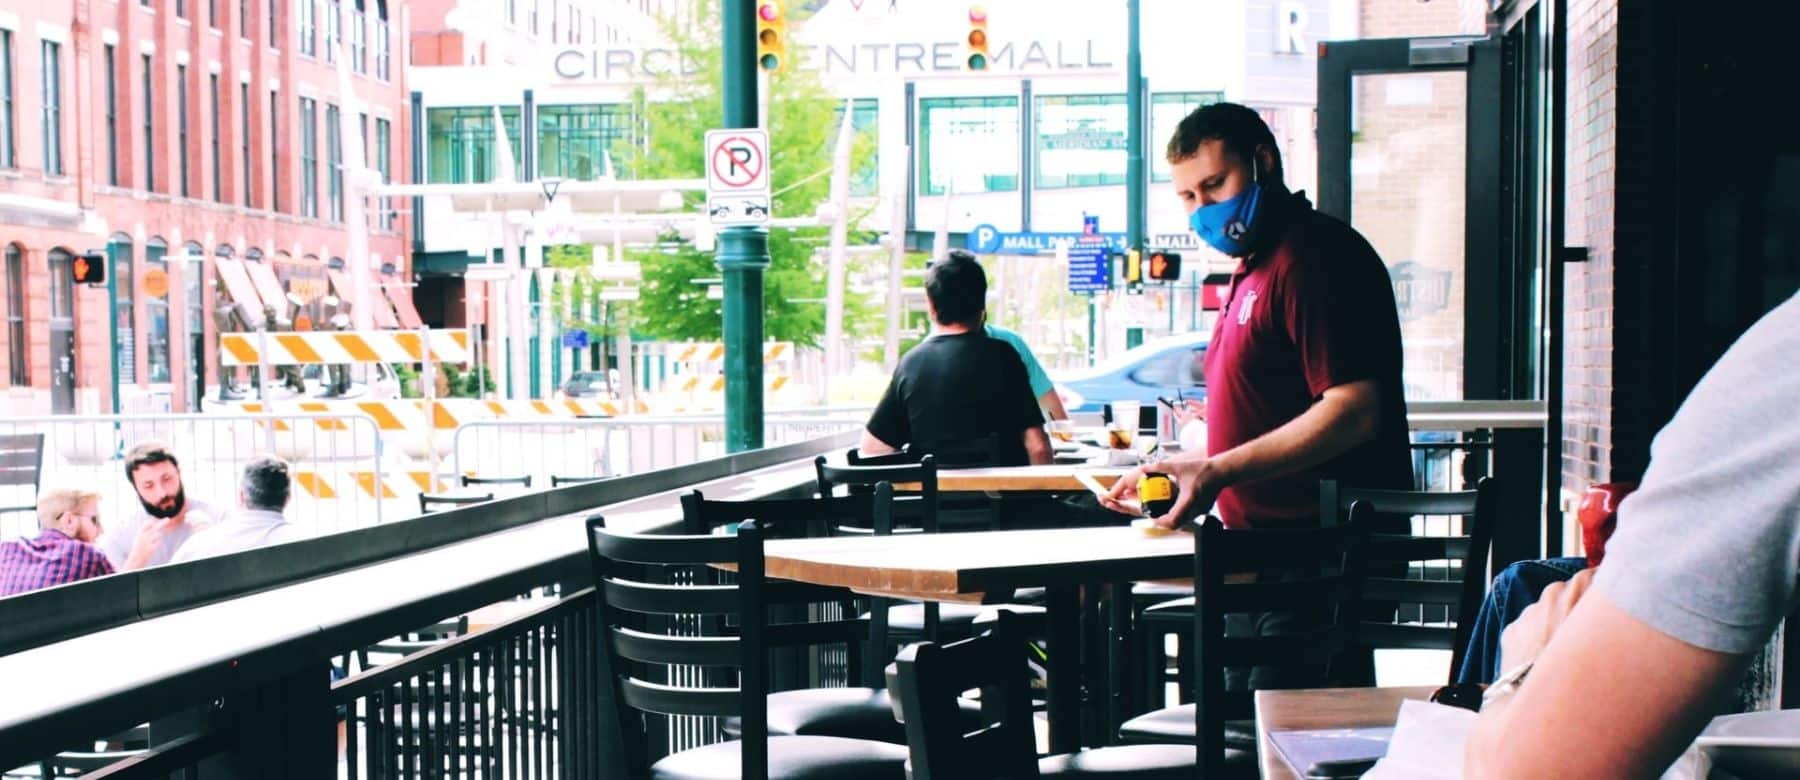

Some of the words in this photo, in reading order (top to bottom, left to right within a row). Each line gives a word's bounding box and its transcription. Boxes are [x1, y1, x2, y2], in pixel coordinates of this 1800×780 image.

[1279, 4, 1306, 54] R
[554, 48, 710, 79] CIRCL
[797, 42, 960, 73] ENTRE
[986, 39, 1113, 70] MALL
[978, 227, 994, 249] P
[1003, 236, 1045, 249] MALL
